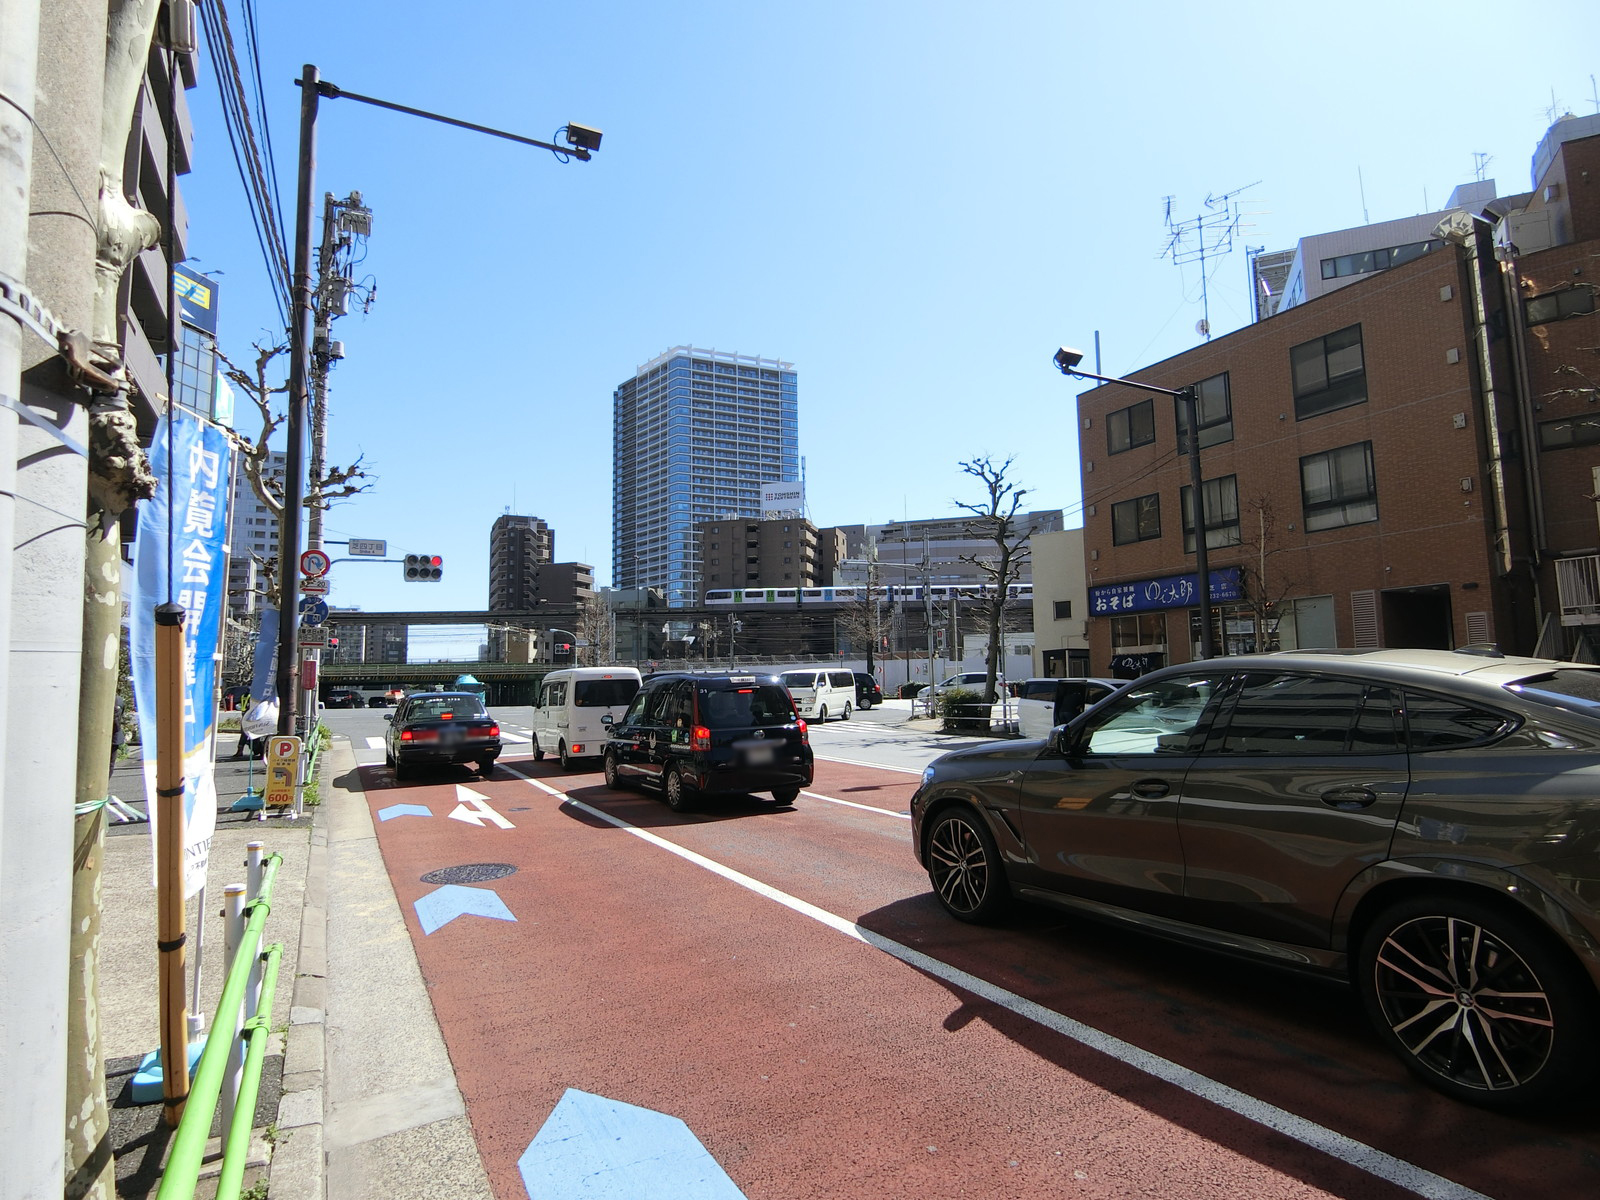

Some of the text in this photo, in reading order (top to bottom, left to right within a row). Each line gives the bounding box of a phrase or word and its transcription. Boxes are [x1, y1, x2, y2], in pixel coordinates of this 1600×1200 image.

[1145, 578, 1193, 605] ゆで太郎
[1096, 593, 1136, 611] おそば
[280, 742, 292, 756] P
